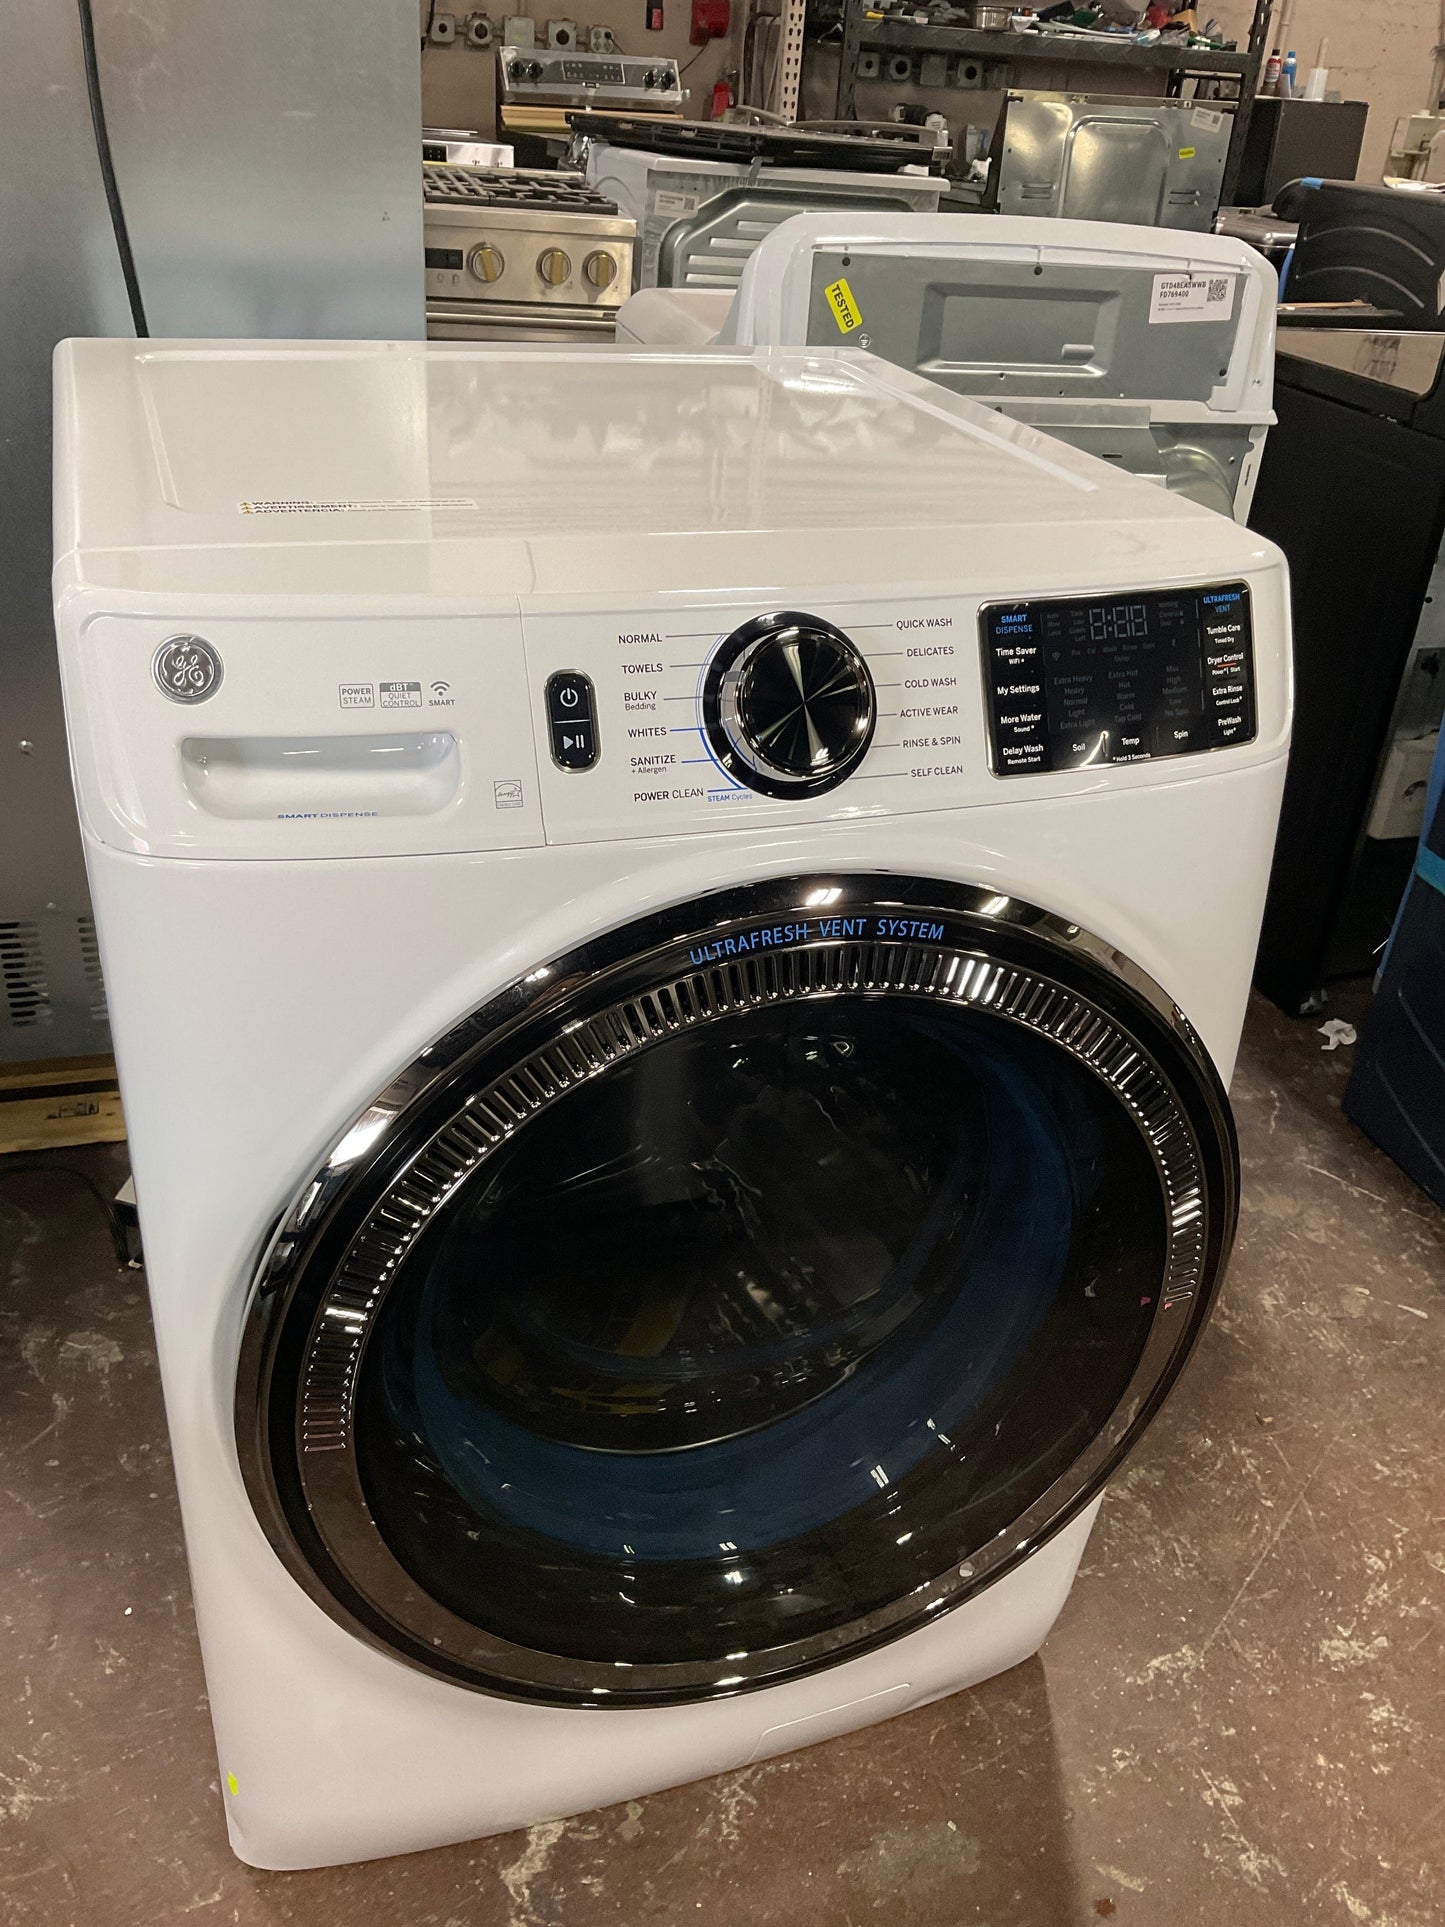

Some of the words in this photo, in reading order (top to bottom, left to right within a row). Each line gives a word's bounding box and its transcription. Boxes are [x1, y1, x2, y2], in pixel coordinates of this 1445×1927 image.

[1160, 290, 1189, 298] FD769400
[832, 284, 854, 328] TESTED
[1203, 593, 1241, 604] ULTRAFRESH
[1215, 604, 1231, 613] VENT
[896, 619, 925, 630] QUICK
[926, 618, 953, 627] WASH
[1001, 614, 1027, 624] SMART
[995, 625, 1033, 635] DISPENSE
[1206, 626, 1227, 635] Tumble
[618, 633, 663, 644] NORMAL
[906, 646, 954, 657] DELICATES
[996, 648, 1014, 657] Time
[1015, 647, 1037, 655] Saver
[1207, 657, 1223, 665] Dryer
[1223, 652, 1244, 662] Control
[622, 663, 664, 674] TOWELS
[904, 679, 929, 689] COLD
[931, 677, 957, 687] WASH
[342, 688, 371, 696] POWER
[997, 686, 1009, 696] My
[1010, 684, 1040, 694] Settings
[1212, 688, 1227, 696] Extra
[1227, 685, 1243, 693] Rinse
[343, 696, 372, 705] STEAM
[388, 692, 411, 700] QUIET
[624, 691, 658, 702] BULKY
[382, 700, 420, 708] CONTROL
[429, 699, 456, 707] SMART
[625, 702, 657, 711] Bedding
[900, 708, 931, 719] ACTIVE
[932, 706, 958, 716] WEAR
[1001, 716, 1020, 724] More
[1020, 713, 1042, 723] Water
[1218, 716, 1242, 726] PreWash
[628, 727, 667, 738] WHITES
[1013, 725, 1031, 733] Sound
[1173, 730, 1189, 740] Spin
[902, 738, 930, 748] RINSE
[931, 738, 938, 746] &
[940, 736, 961, 745] SPIN
[1121, 737, 1140, 746] Temp
[1003, 747, 1023, 756] Delay
[1024, 744, 1044, 754] Wash
[1072, 743, 1086, 752] Soil
[630, 755, 676, 766] SANITIZE
[637, 765, 667, 775] Allergen
[910, 768, 932, 778] SELF
[934, 765, 963, 776] CLEAN
[634, 791, 670, 802] POWER
[672, 788, 704, 799] CLEAN
[707, 794, 730, 803] STEAM
[731, 793, 753, 801] Cycles
[690, 923, 808, 966] ULTRAFRESH
[819, 918, 867, 937] VENT
[876, 919, 945, 941] SYSTEM
